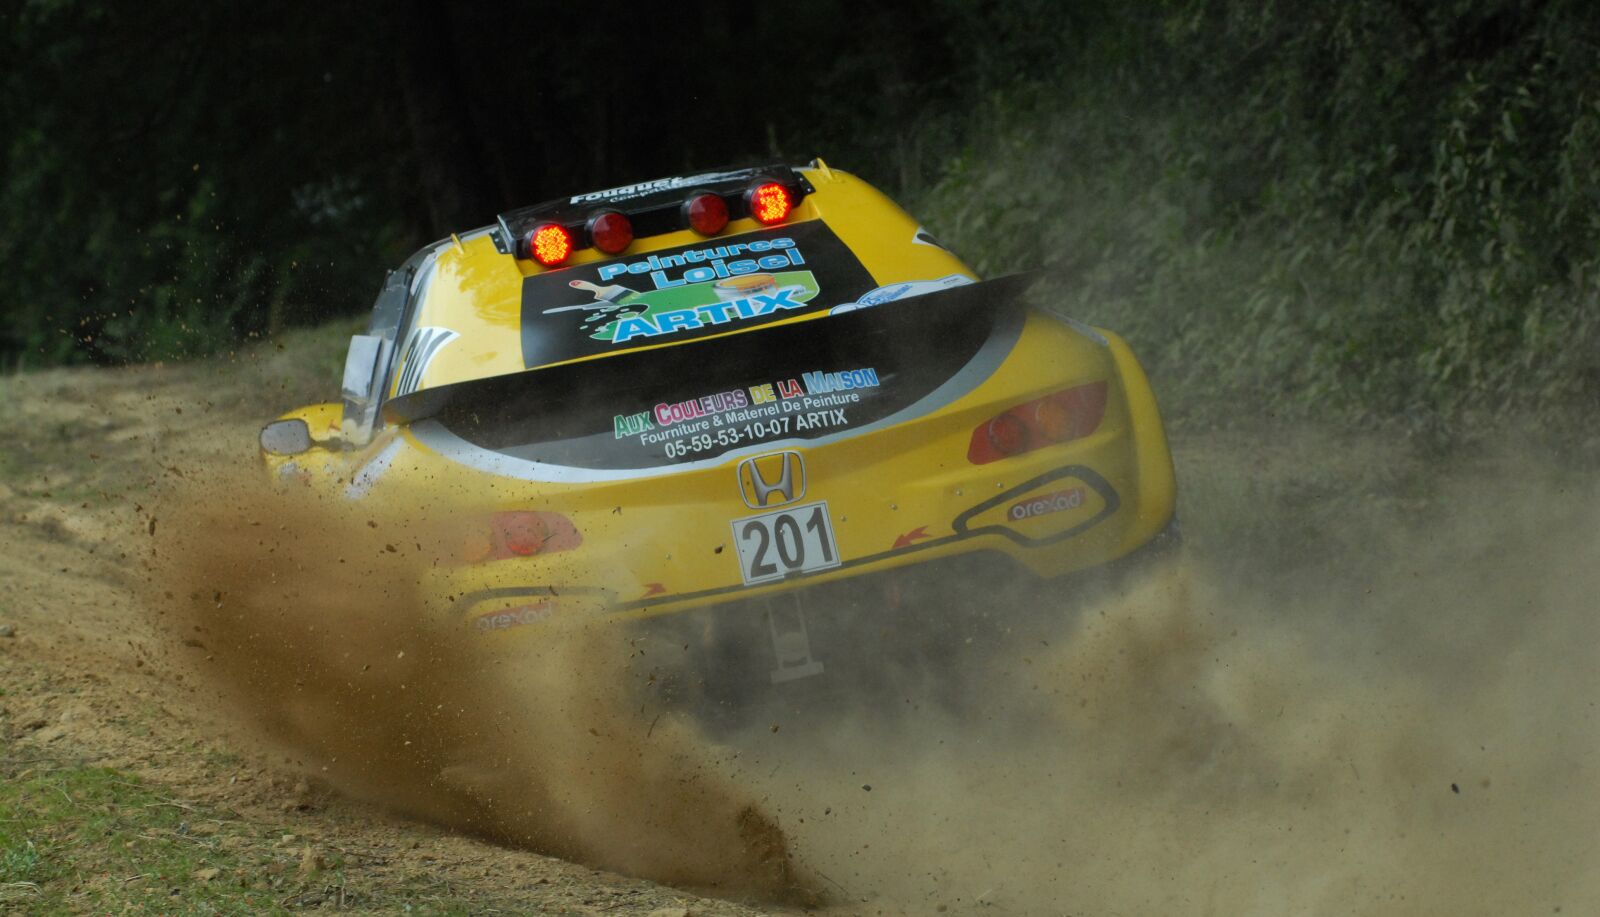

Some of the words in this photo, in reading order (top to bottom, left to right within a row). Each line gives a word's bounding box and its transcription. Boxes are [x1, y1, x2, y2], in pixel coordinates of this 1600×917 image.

[569, 176, 683, 205] Fouquet
[598, 237, 795, 281] Peintures
[650, 247, 806, 290] Loisel
[611, 289, 808, 343] ARTIX
[640, 419, 709, 446] Fourniture
[713, 414, 723, 427] &
[782, 399, 801, 413] De
[803, 392, 860, 409] Peinture
[664, 416, 790, 459] 05-59-53-10-07
[796, 408, 848, 431] ARTIX
[741, 506, 835, 578] 201
